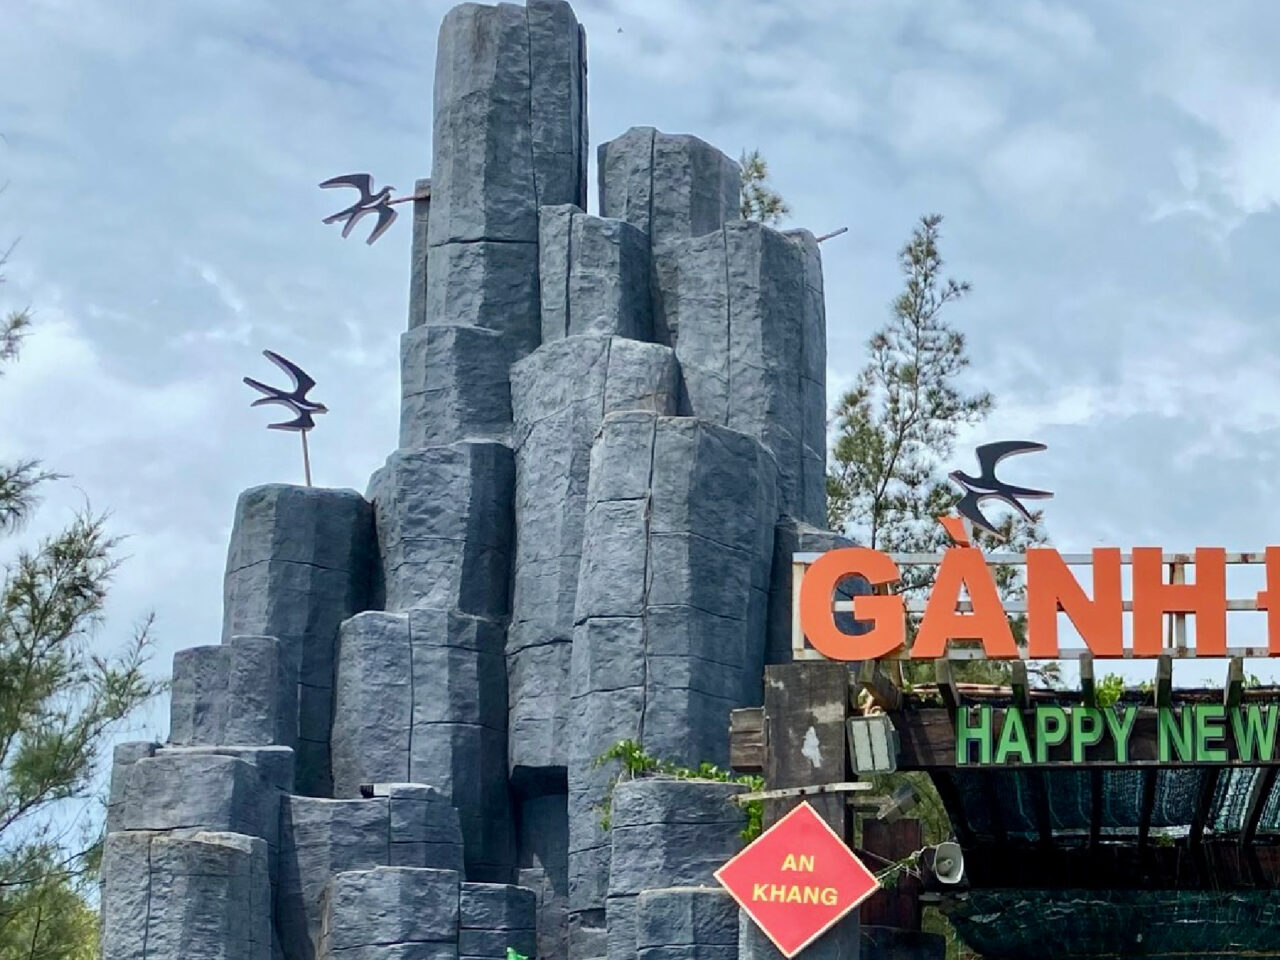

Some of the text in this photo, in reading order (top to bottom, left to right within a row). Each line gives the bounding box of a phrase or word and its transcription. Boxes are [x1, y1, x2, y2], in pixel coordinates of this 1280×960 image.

[799, 516, 1226, 660] GÀNH
[955, 704, 1139, 766] HAPPY
[1157, 703, 1280, 764] NEW
[781, 853, 815, 872] AN
[752, 883, 839, 906] KHANG
